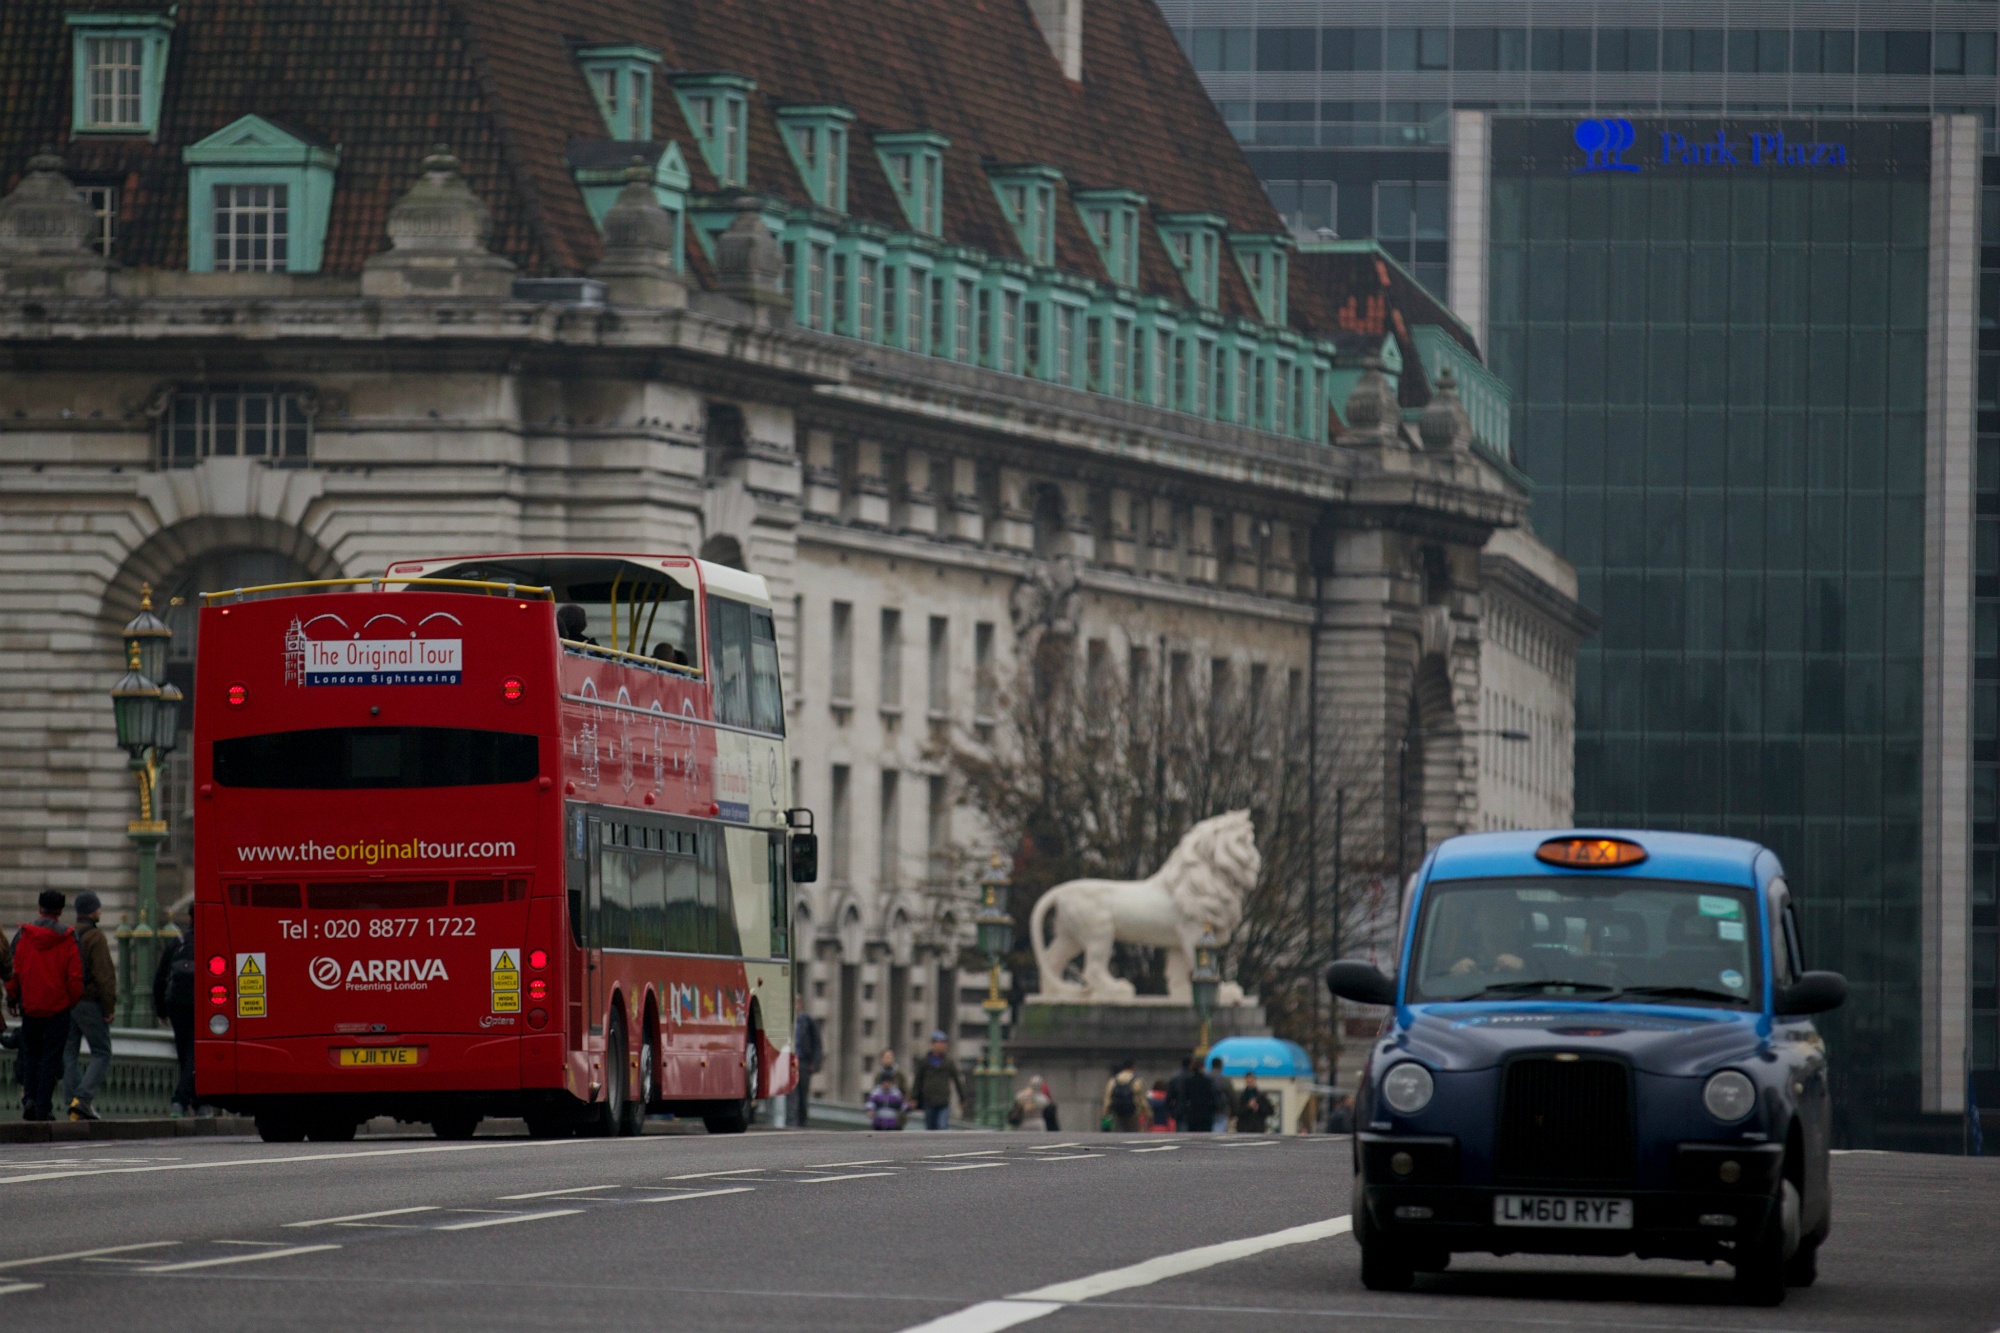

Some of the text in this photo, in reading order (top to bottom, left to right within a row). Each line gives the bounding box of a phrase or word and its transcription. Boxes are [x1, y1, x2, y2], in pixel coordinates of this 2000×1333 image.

[1660, 130, 1847, 166] Park Plaza
[312, 641, 454, 671] The Original Tour
[314, 673, 457, 684] London Sightseeing
[237, 837, 516, 866] www.theoriginaltour.com
[323, 919, 361, 938] 020
[368, 918, 419, 937] 8877
[426, 917, 477, 937] 1722
[345, 958, 450, 982] ARRIVA
[345, 981, 428, 993] Presenting London
[381, 1050, 406, 1063] TVE
[1504, 1198, 1621, 1222] LM60 RYF
